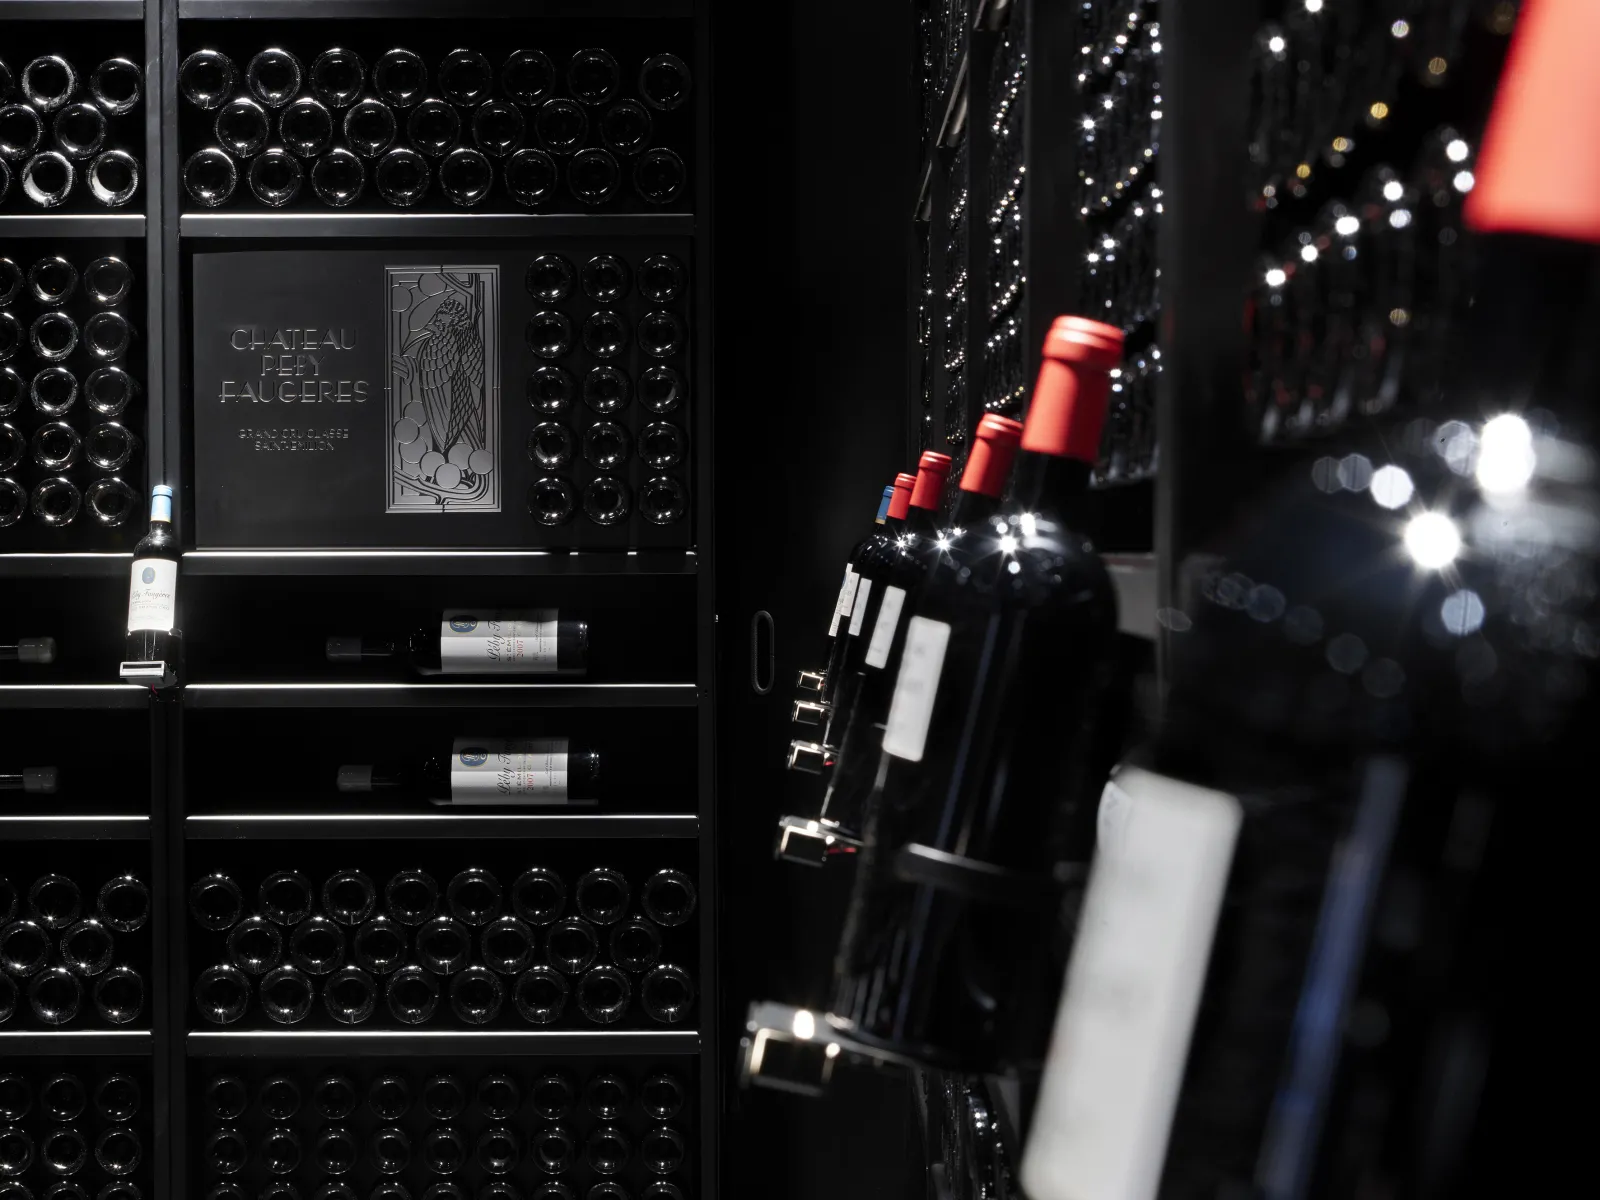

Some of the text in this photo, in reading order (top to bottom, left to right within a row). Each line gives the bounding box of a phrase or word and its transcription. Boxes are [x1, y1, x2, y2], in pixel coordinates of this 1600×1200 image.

[230, 328, 358, 350] CHATEAU
[260, 354, 325, 376] PEBY
[218, 380, 370, 403] FAUGERES
[238, 428, 349, 439] GRAND CRU CLASSE
[516, 639, 524, 657] 2007
